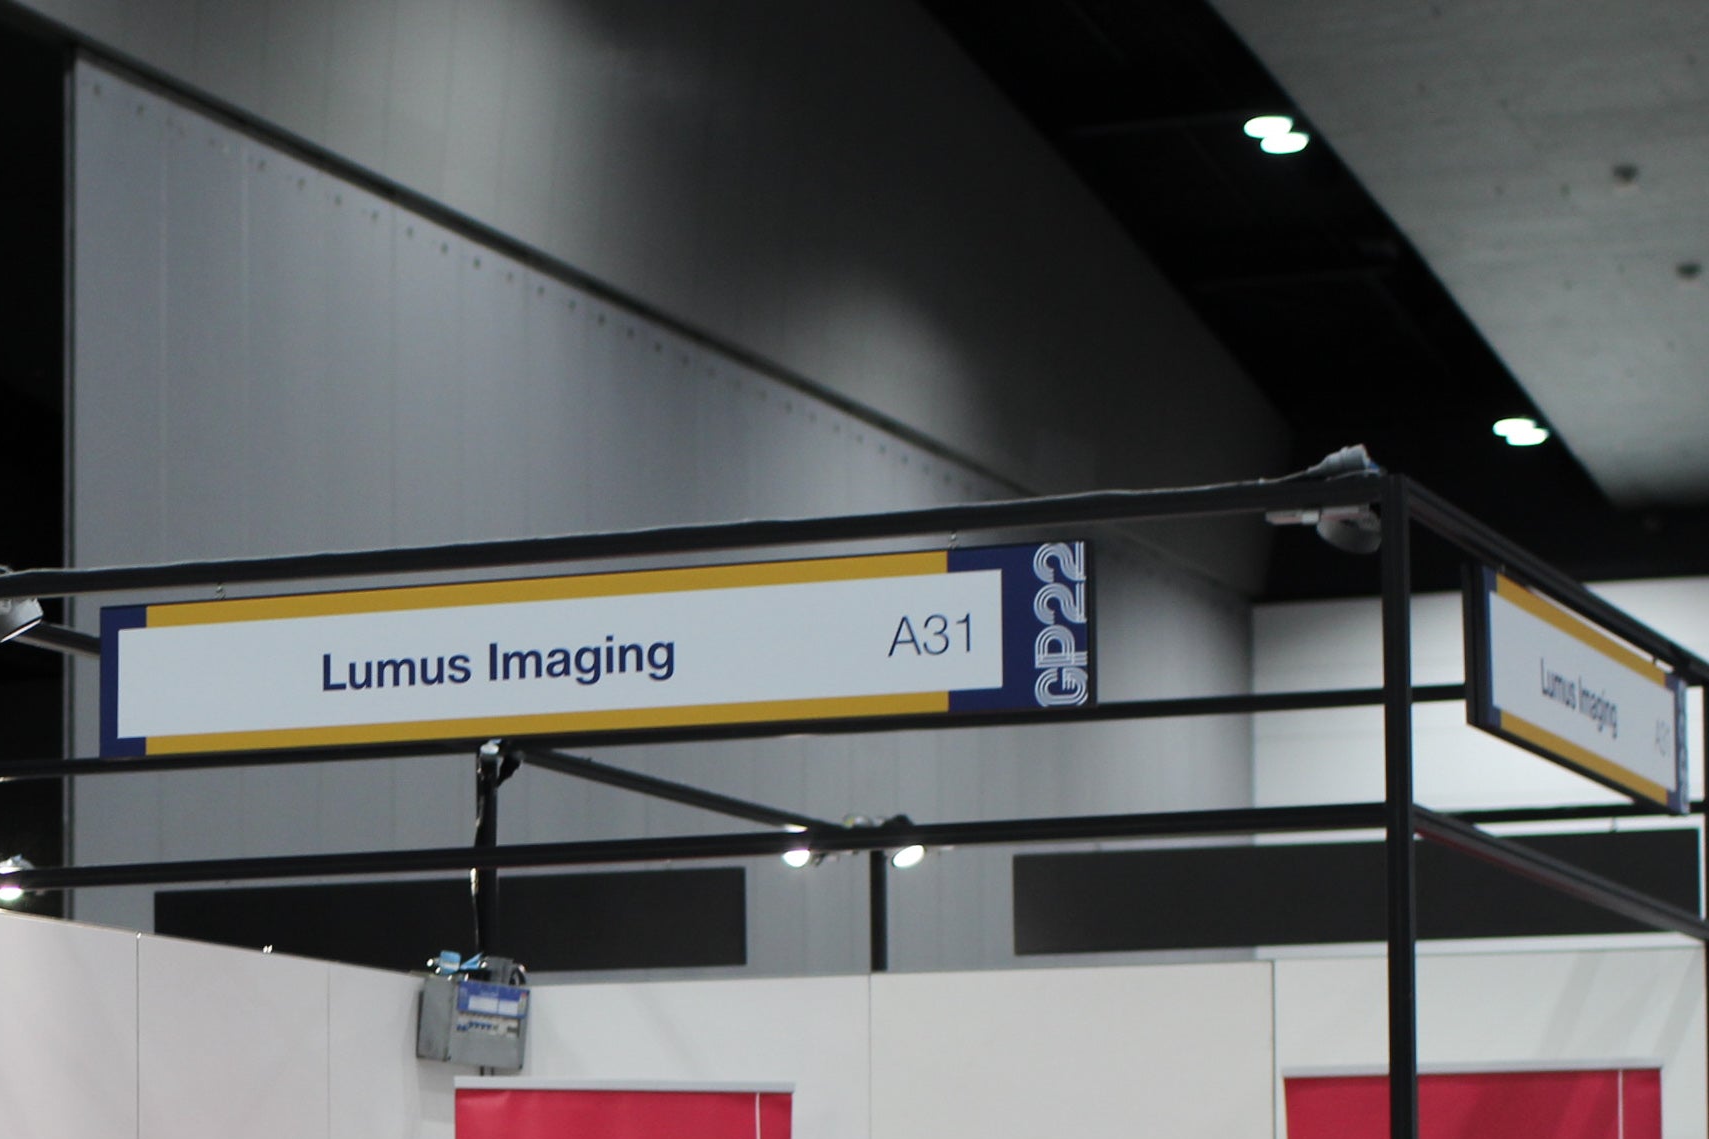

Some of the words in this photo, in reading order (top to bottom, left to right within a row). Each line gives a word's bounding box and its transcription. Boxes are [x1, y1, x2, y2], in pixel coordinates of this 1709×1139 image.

[322, 649, 472, 692] Lumus
[489, 636, 677, 686] Imaging
[889, 612, 976, 659] A31
[1034, 541, 1088, 709] GP22
[1539, 657, 1577, 712] Lumus
[1578, 675, 1619, 741] Imaging
